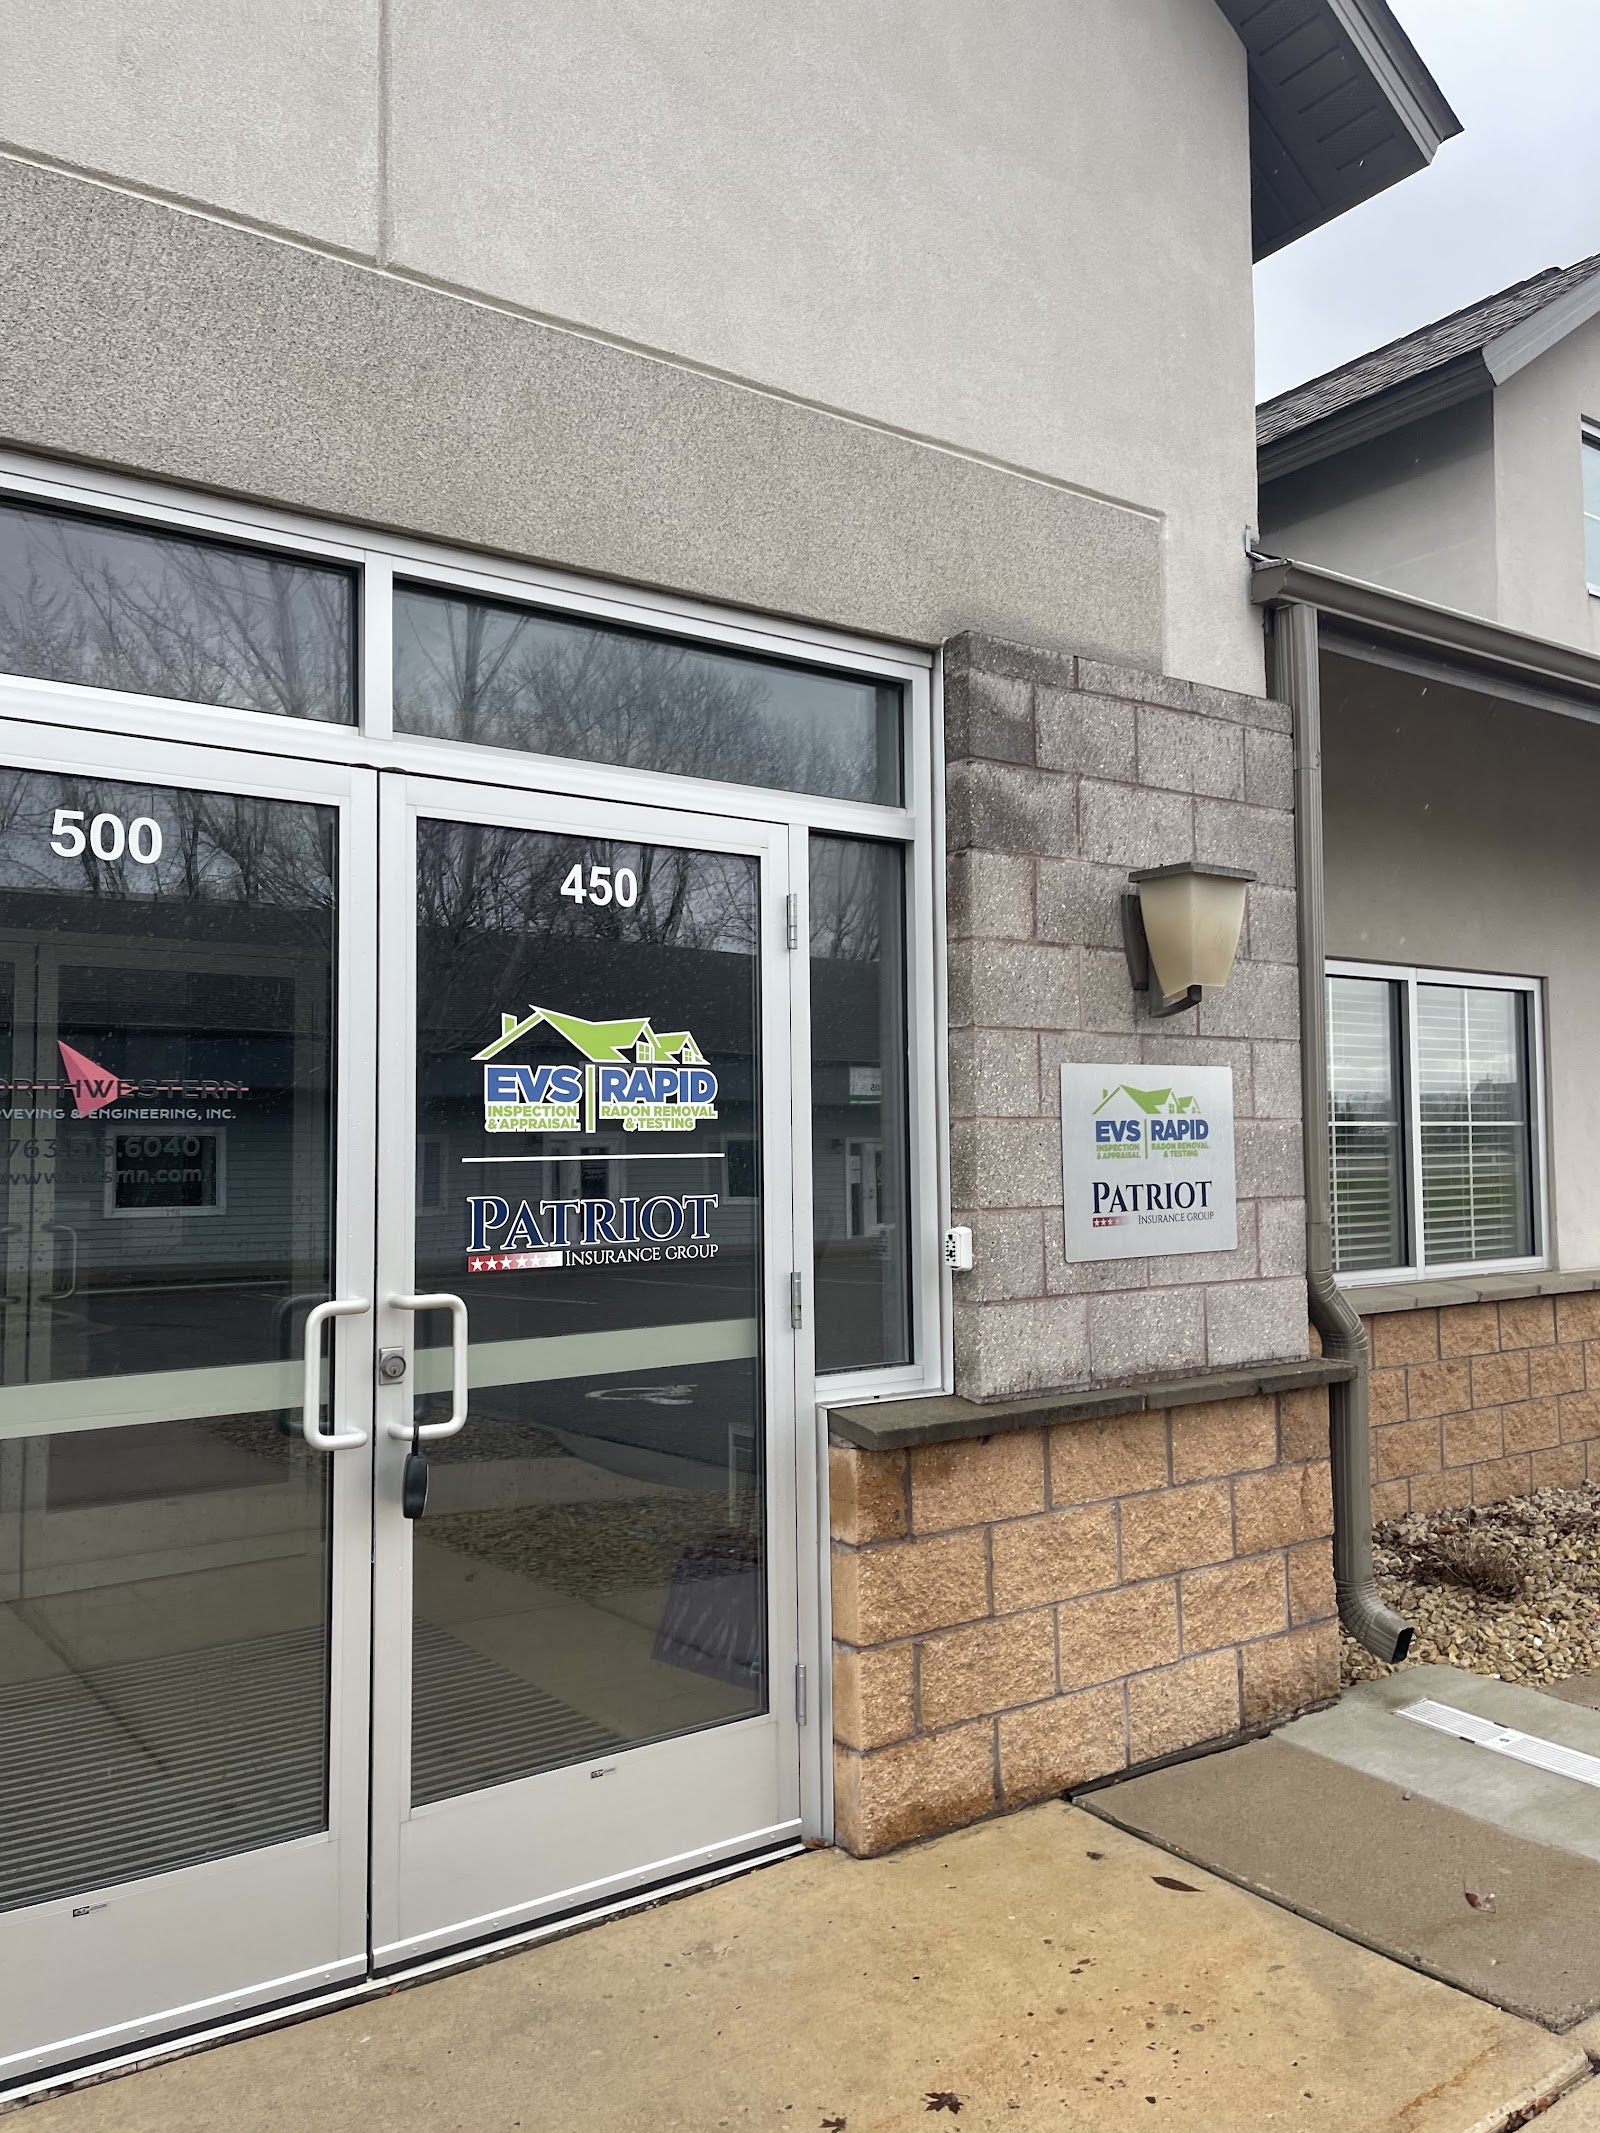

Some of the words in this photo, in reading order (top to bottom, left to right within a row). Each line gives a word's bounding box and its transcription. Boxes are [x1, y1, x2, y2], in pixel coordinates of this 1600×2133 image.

[50, 809, 163, 864] 500
[560, 863, 638, 908] 450
[485, 1066, 583, 1103] EVS
[600, 1067, 718, 1104] RAPID
[0, 1108, 66, 1120] VEYING
[89, 1109, 203, 1121] ENGINEERING,
[206, 1109, 237, 1120] INC.
[486, 1104, 579, 1118] INSPECTION
[600, 1104, 651, 1117] RADON
[653, 1104, 717, 1117] REMOVAL
[486, 1118, 500, 1130] &
[501, 1117, 580, 1130] APPRAISAL
[625, 1117, 636, 1130] &
[638, 1116, 695, 1129] TESTING
[1150, 1119, 1209, 1141] RAPID
[1095, 1120, 1141, 1142] EVS
[1096, 1143, 1140, 1152] INSPECTION
[1177, 1142, 1209, 1150] REMOVAL
[1102, 1152, 1141, 1160] APPRAISAL
[1170, 1150, 1198, 1158] TESTING
[1091, 1180, 1213, 1215] PATRIOT
[466, 1194, 719, 1252] PATRIOT
[1138, 1213, 1185, 1224] INSURANCE
[1186, 1211, 1214, 1221] GROUP
[565, 1246, 661, 1267] INSURANCE
[664, 1243, 719, 1261] GROUP
